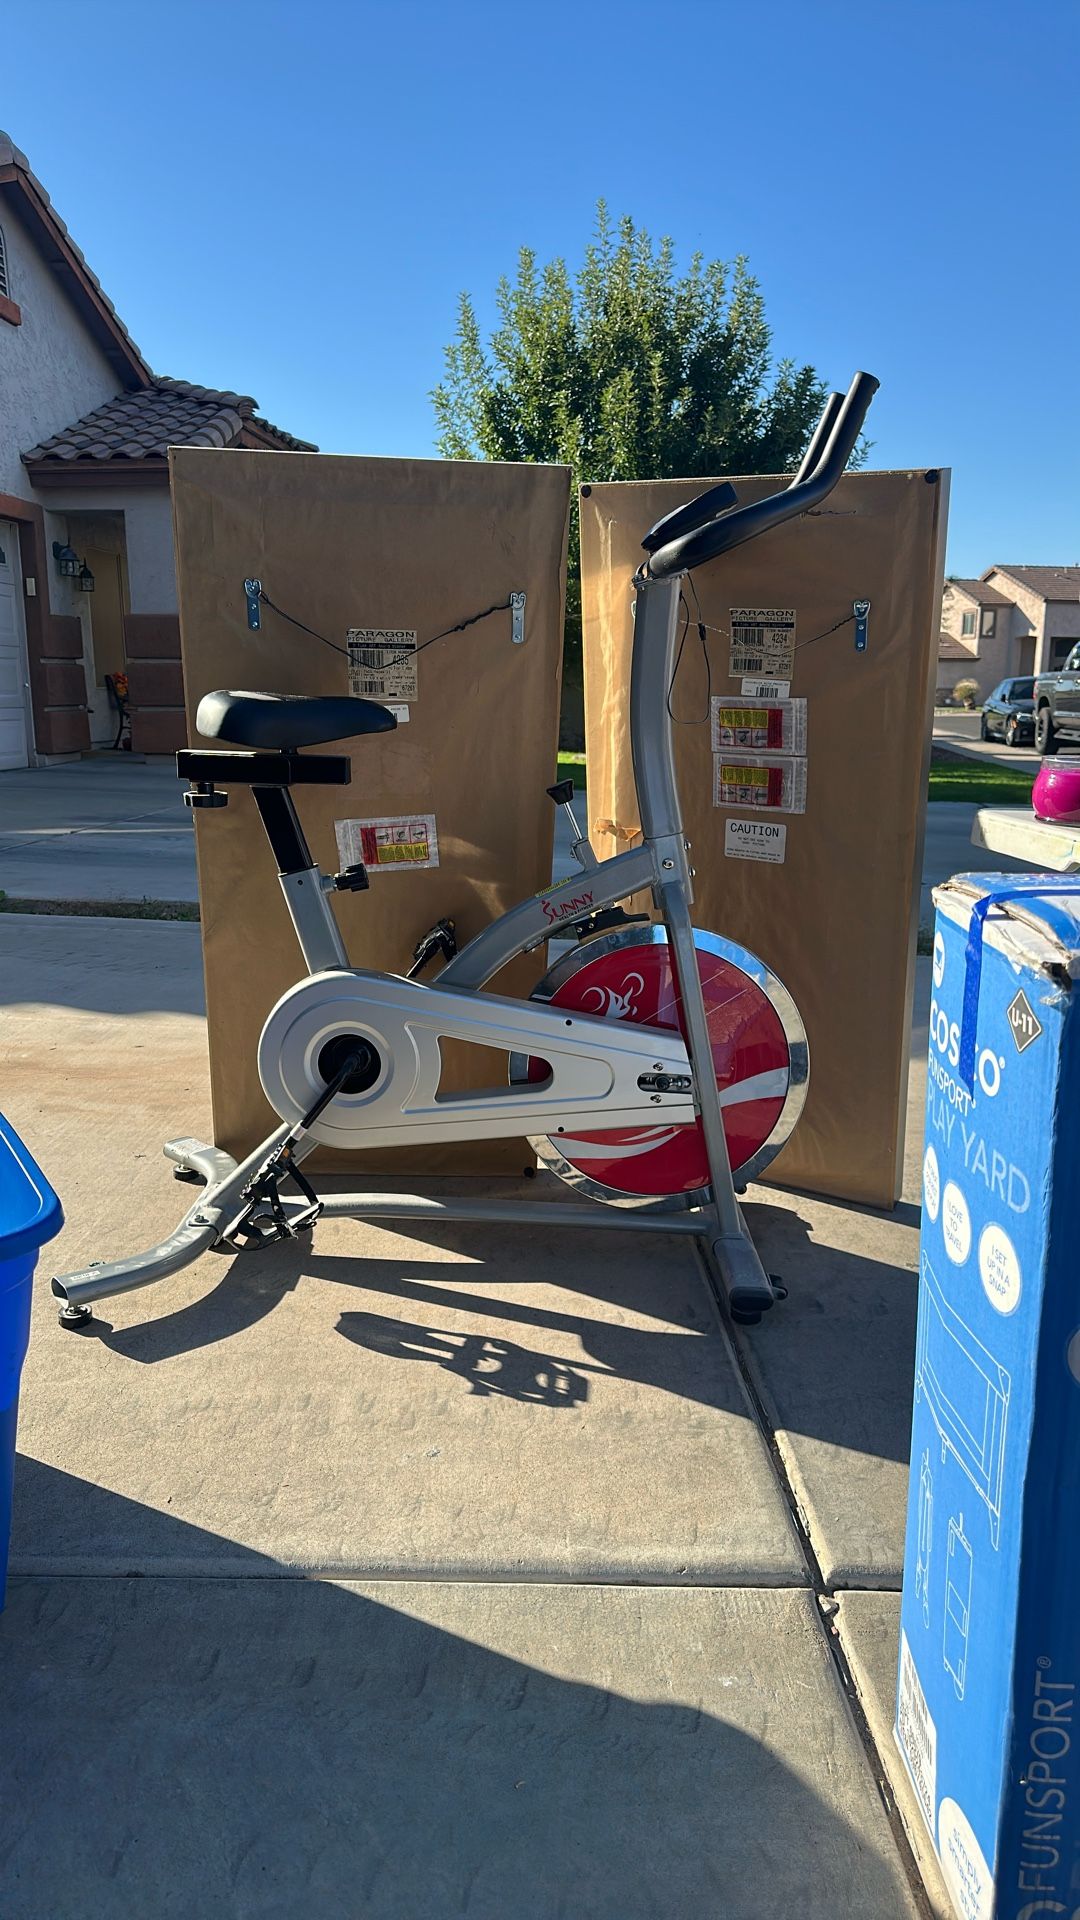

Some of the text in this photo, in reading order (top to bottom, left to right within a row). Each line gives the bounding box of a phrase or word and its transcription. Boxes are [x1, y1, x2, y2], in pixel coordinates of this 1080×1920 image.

[772, 633, 787, 643] 4234
[393, 655, 409, 665] 4235
[730, 822, 779, 838] CAUTION
[541, 891, 593, 925] SUNNY
[1011, 1007, 1032, 1036] U-11
[930, 1000, 1005, 1097] COSO®
[927, 1077, 955, 1149] PLAY
[961, 1121, 1031, 1214] YARD
[949, 1205, 963, 1224] LOVE
[950, 1217, 958, 1232] TO
[987, 1256, 996, 1271] UP
[996, 1265, 1004, 1280] IN
[995, 1249, 1007, 1266] SET
[989, 1273, 1006, 1296] SNAP
[953, 1828, 981, 1895] simply
